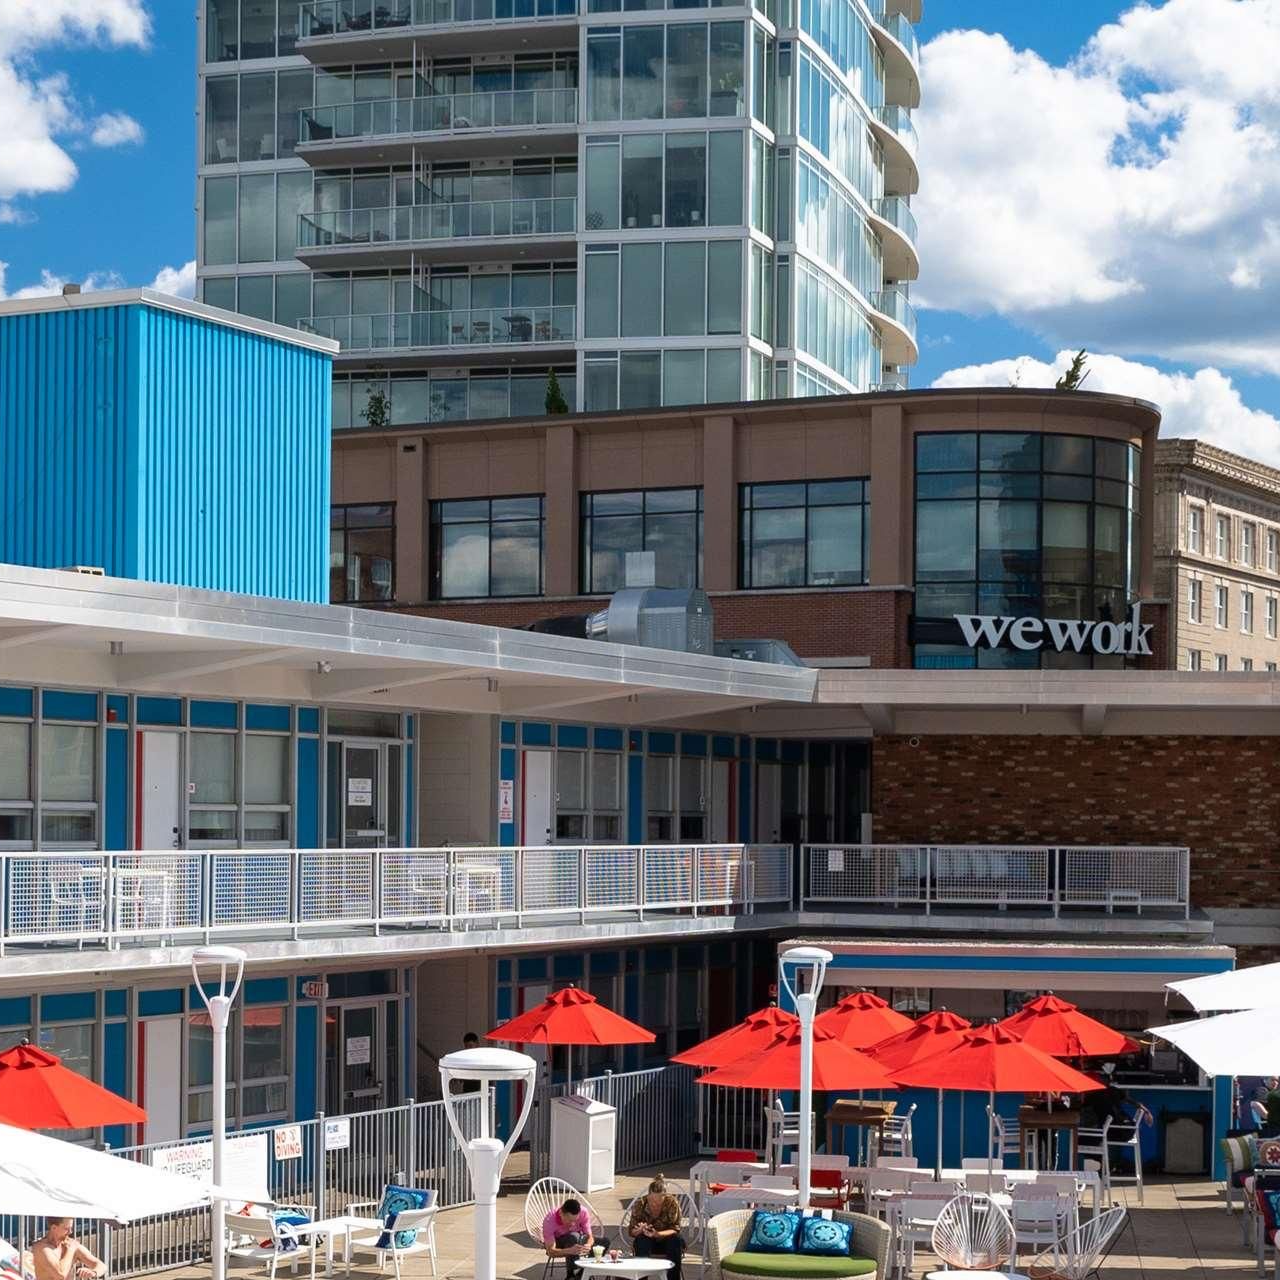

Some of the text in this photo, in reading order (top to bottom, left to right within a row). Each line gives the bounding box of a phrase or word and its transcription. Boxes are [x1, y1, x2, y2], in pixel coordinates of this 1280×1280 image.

[953, 602, 1154, 656] wework
[276, 1131, 286, 1144] NO
[166, 1147, 205, 1163] WARNING
[276, 1142, 301, 1157] DIVING
[170, 1159, 212, 1175] LIFEGUARD
